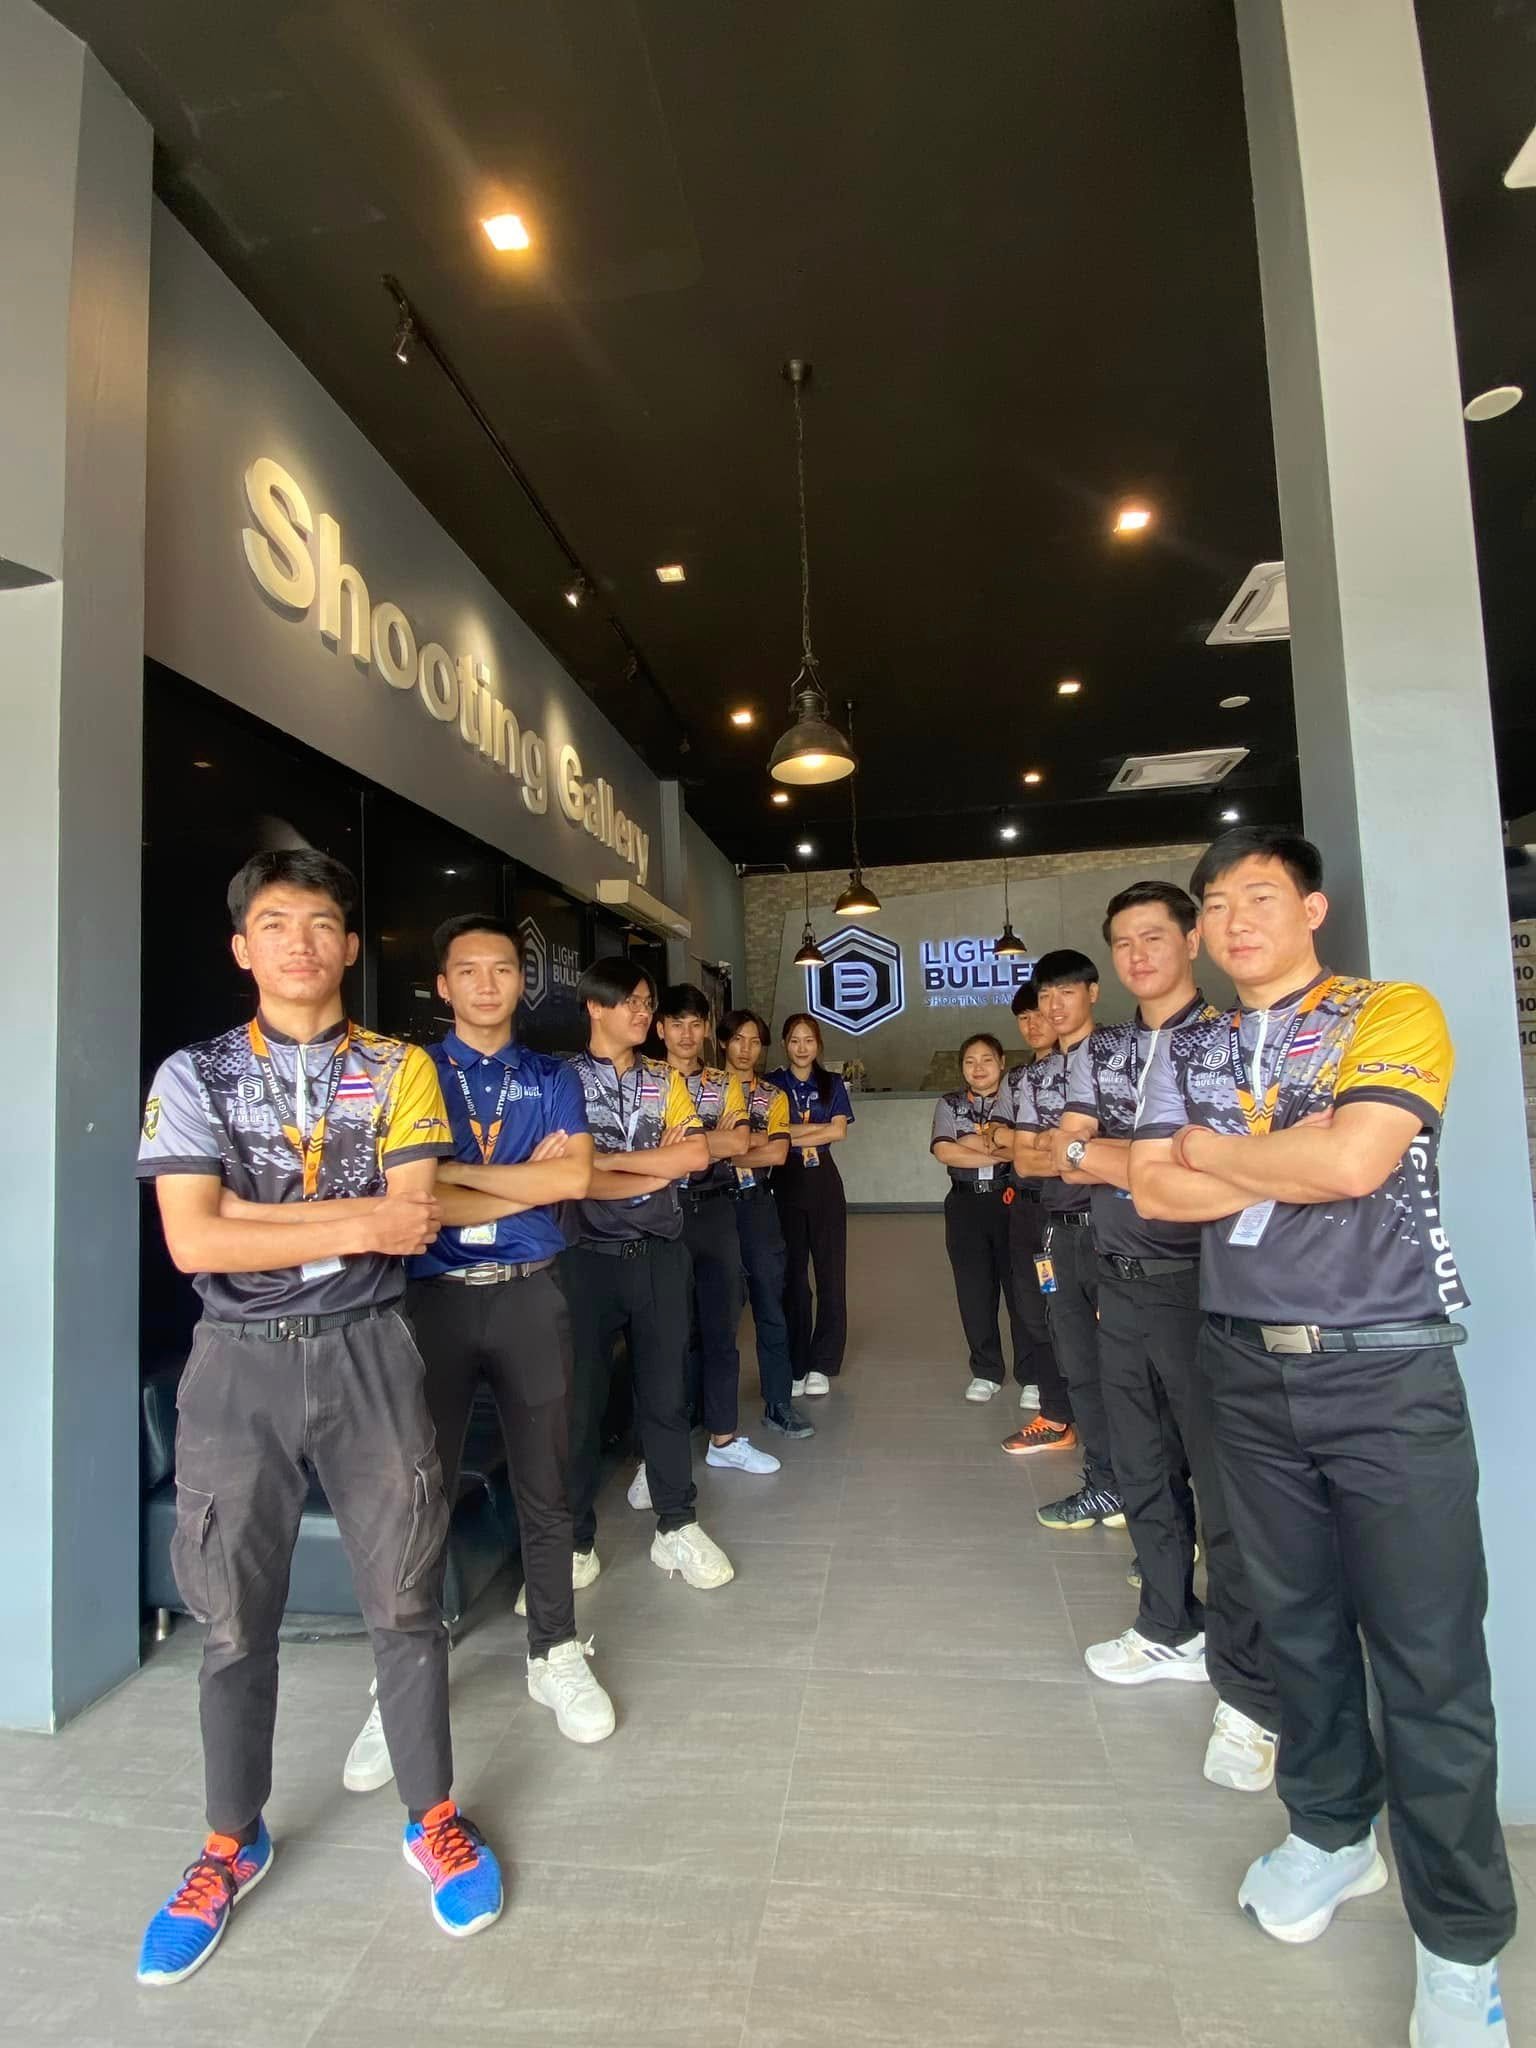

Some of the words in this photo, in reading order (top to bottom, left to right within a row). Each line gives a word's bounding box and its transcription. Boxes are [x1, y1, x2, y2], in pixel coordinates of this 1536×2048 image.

[242, 457, 547, 814] Shooting
[558, 744, 649, 885] Gallery
[552, 944, 579, 968] LIGHT
[925, 962, 1038, 989] BULLE
